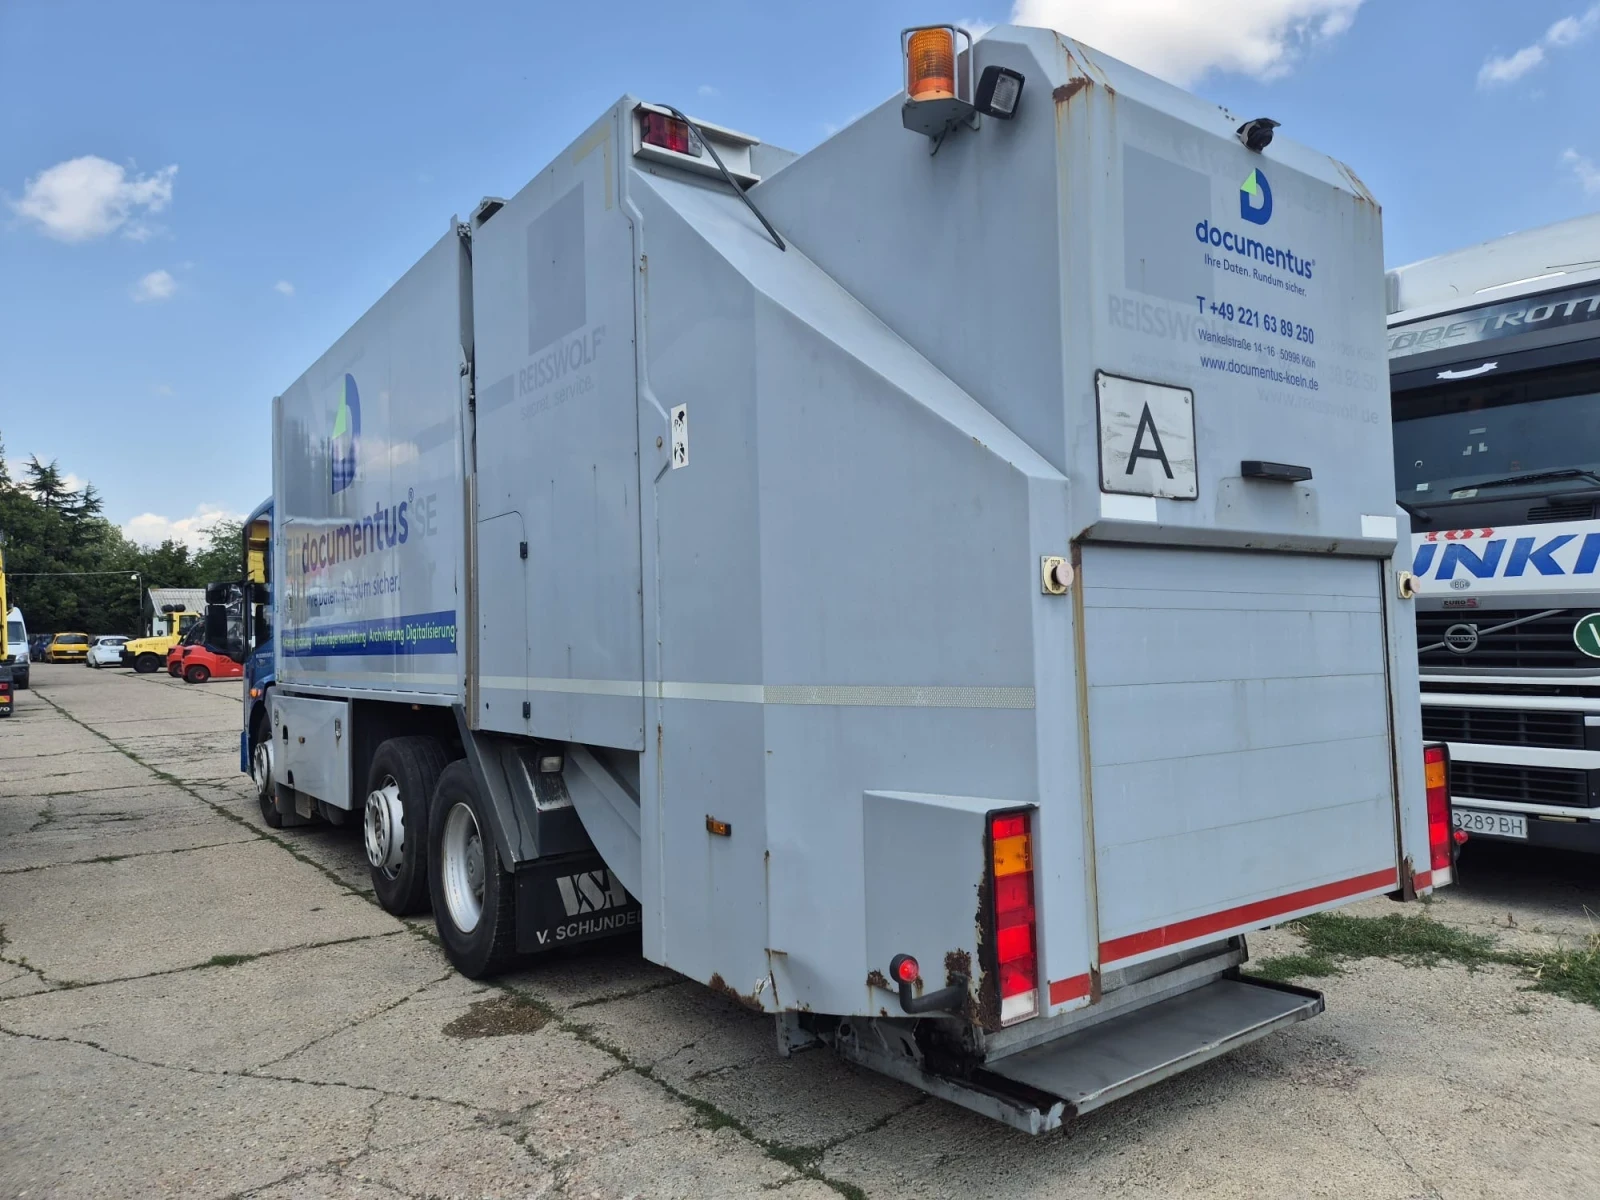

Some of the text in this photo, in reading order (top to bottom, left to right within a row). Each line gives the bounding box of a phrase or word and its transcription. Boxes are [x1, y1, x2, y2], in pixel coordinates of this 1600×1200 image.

[1204, 253, 1307, 297] Ihre Daten. Rundum sicher.
[1196, 295, 1314, 345] T +49 221 63 89 250
[1198, 328, 1252, 351] Wankelstraße
[1280, 348, 1301, 365] 50996
[1301, 354, 1316, 369] Köln
[1200, 355, 1319, 391] www.documentus-koeln.de
[1125, 400, 1174, 479] A
[373, 571, 400, 596] sicher.
[1454, 581, 1465, 589] BG
[369, 627, 404, 645] Archivierung
[406, 622, 456, 645] Digitalisierung
[1453, 812, 1522, 835] 3289 BH
[536, 929, 550, 944] V.
